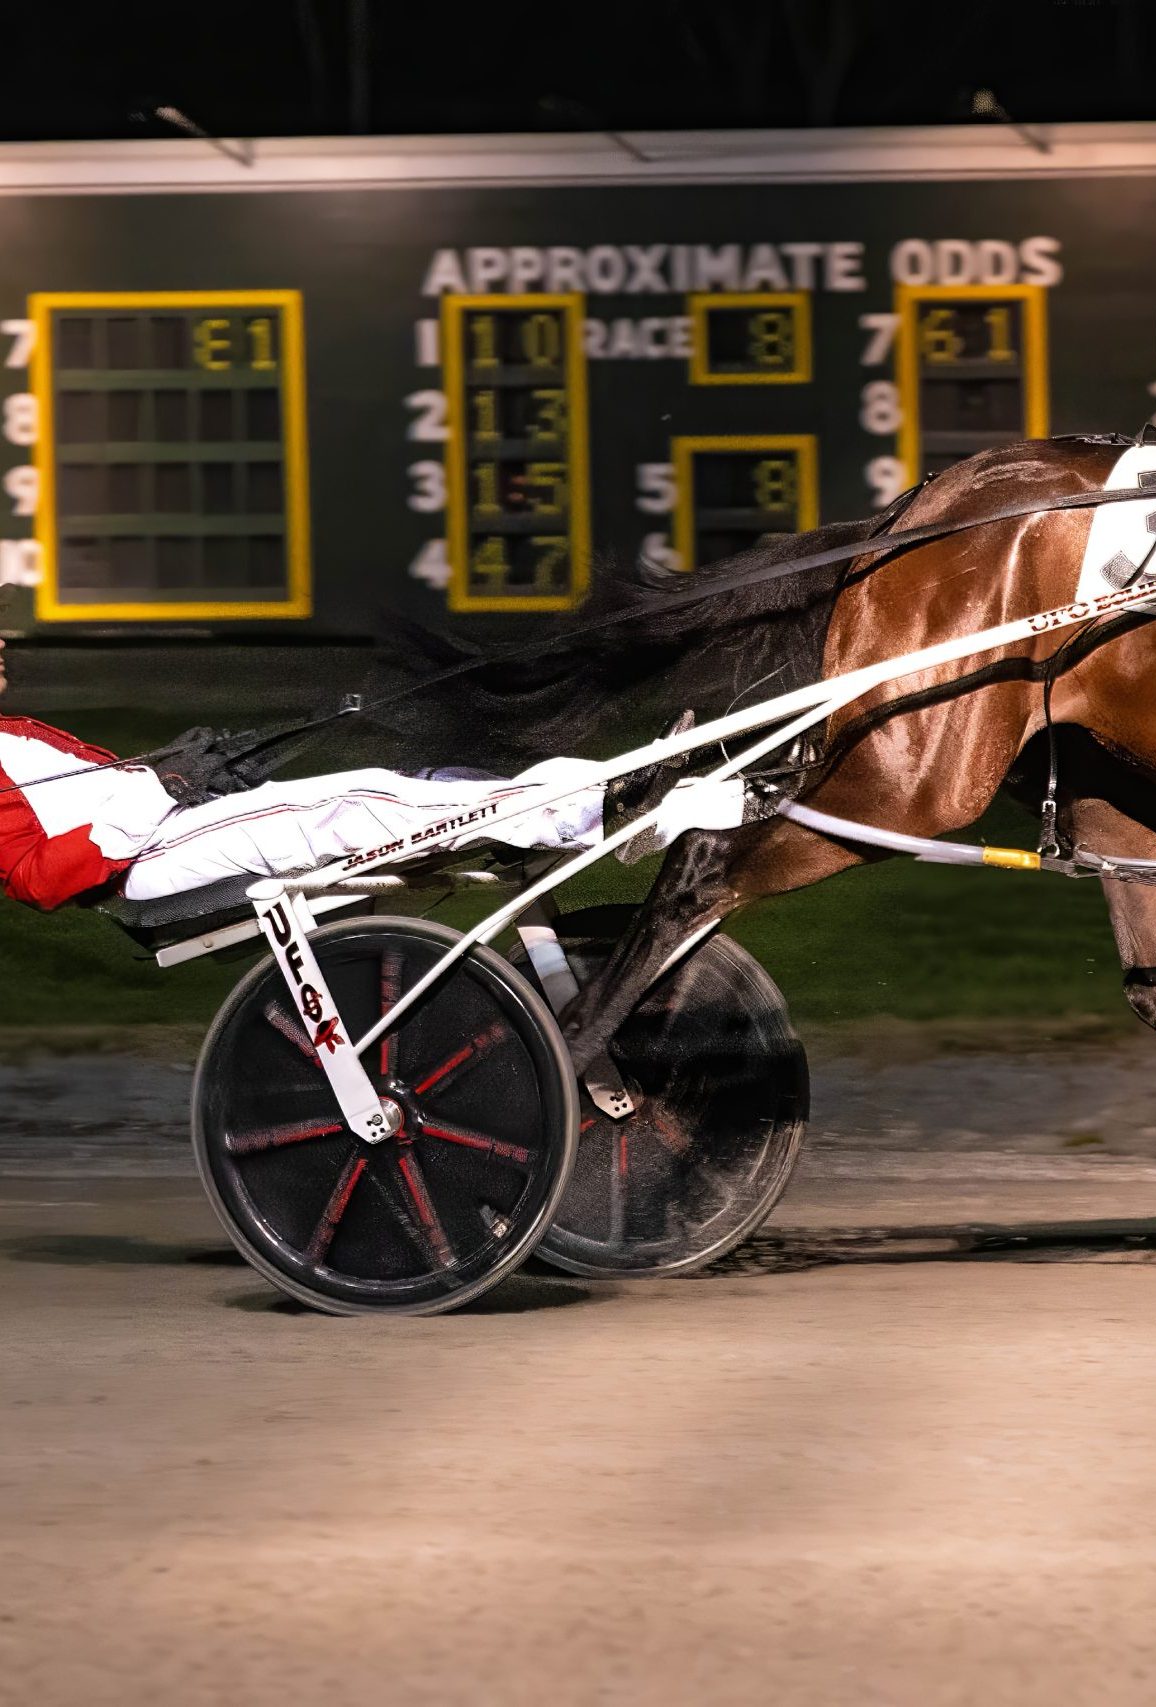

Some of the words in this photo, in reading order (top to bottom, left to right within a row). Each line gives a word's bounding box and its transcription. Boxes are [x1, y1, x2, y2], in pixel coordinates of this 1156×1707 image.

[421, 244, 869, 295] APPROXIMATE
[891, 236, 1064, 287] ODDS
[0, 319, 37, 368] 7
[415, 318, 440, 367] 1
[581, 316, 696, 358] RACE
[859, 313, 902, 366] 7
[3, 393, 39, 446] 8
[405, 390, 453, 442] 2
[860, 381, 904, 436] 8
[3, 465, 39, 516] 9
[406, 461, 448, 513] 3
[636, 462, 678, 514] 5
[864, 455, 909, 509] 9
[408, 538, 453, 590] 4
[342, 838, 405, 871] JASON
[411, 802, 499, 845] BARTLETT
